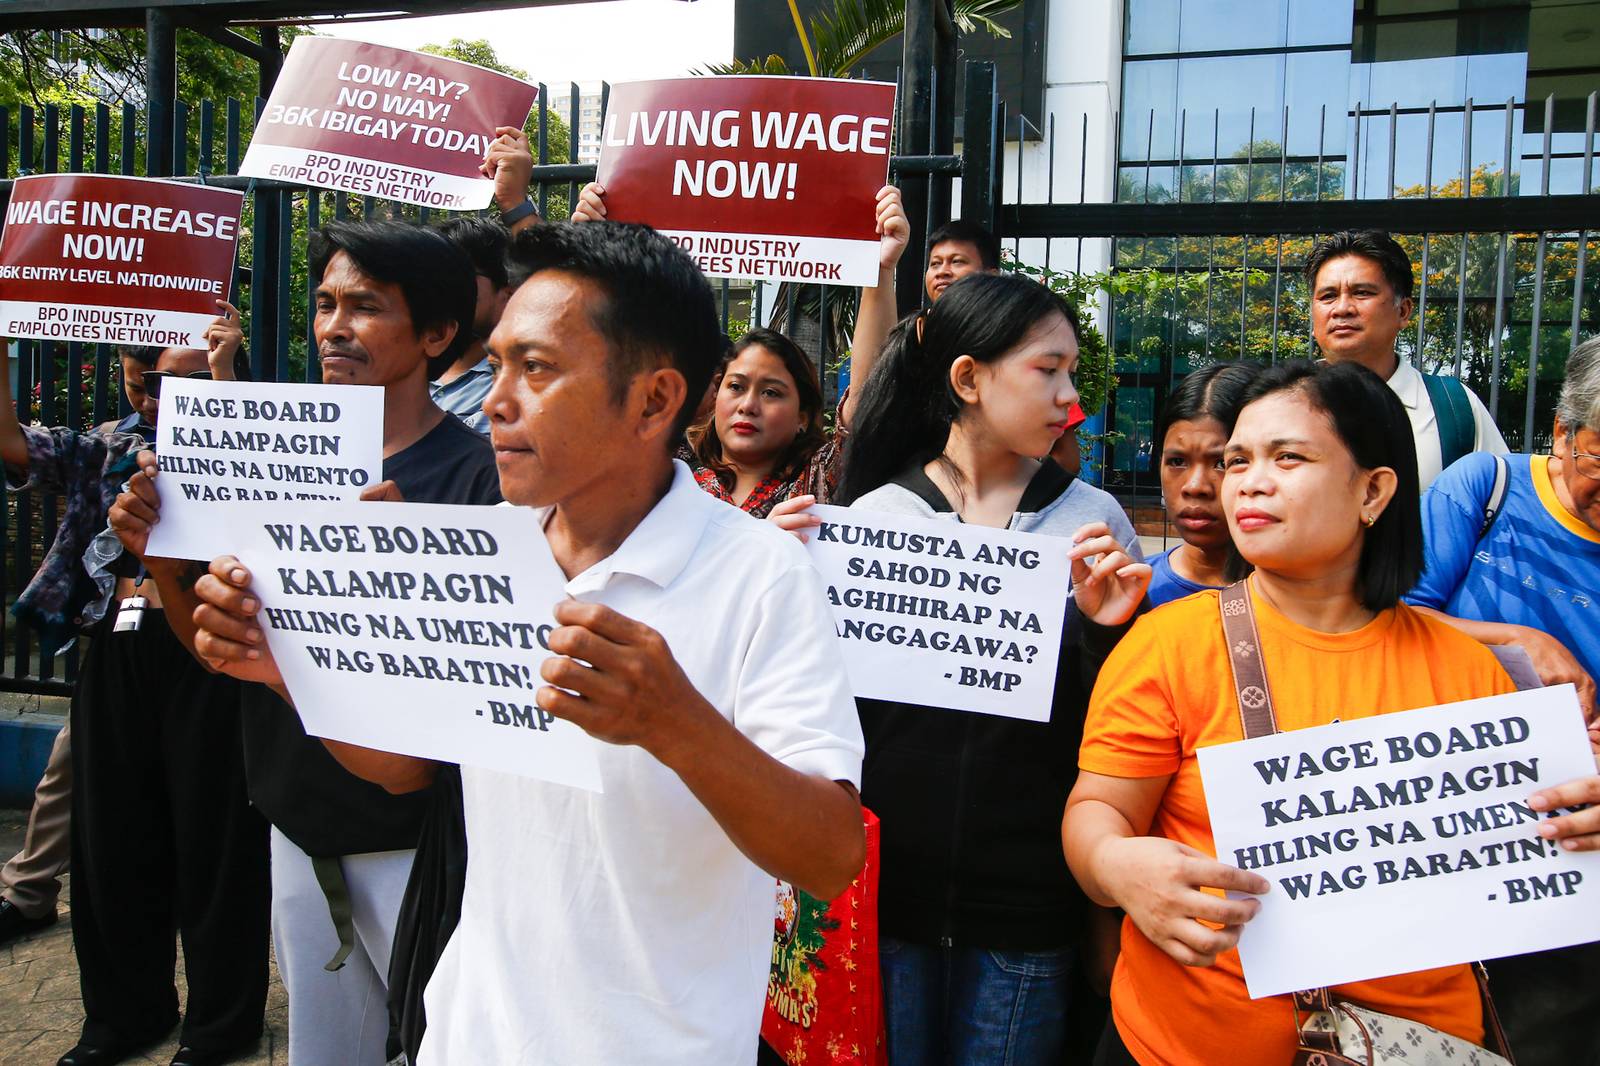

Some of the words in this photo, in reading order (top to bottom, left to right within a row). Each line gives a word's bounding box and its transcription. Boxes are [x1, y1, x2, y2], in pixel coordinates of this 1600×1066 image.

[337, 61, 401, 88] LOW
[401, 72, 470, 101] PAY?
[267, 105, 319, 128] 36K
[319, 111, 408, 141] IBIGAY
[336, 87, 379, 111] NO
[382, 94, 452, 123] WAY!
[606, 110, 740, 148] LIVING
[751, 110, 890, 155] WAGE
[269, 163, 372, 192] EMPLOYEES
[376, 182, 466, 207] NETWORK
[305, 154, 341, 171] BPO
[344, 160, 435, 188] INDUSTRY
[671, 159, 799, 200] NOW!
[8, 200, 77, 225] WAGE
[82, 201, 237, 241] INCREASE
[62, 233, 145, 263] NOW!
[699, 237, 800, 258] INDUSTRY
[22, 266, 68, 282] ENTRY
[69, 269, 114, 285] LEVEL
[117, 271, 224, 294] NATIONWIDE
[738, 258, 842, 280] NETWORK
[8, 321, 101, 339] EMPLOYEES
[105, 327, 191, 346] NETWORK
[38, 307, 68, 321] BPO
[72, 309, 156, 328] INDUSTRY
[175, 395, 238, 419] WAGE
[242, 400, 341, 423] BOARD
[172, 426, 341, 456] KALAMPAGIN
[157, 454, 227, 476] HILING
[232, 461, 264, 480] NA
[267, 463, 369, 487] UMENTO
[181, 483, 231, 501] WAG
[264, 524, 366, 553] WAGE
[368, 525, 498, 556] BOARD
[817, 522, 966, 560] KUMUSTA
[972, 543, 1041, 570] ANG
[277, 567, 515, 605] KALAMPAGIN
[847, 557, 951, 588] SAHOD
[958, 571, 1002, 595] NG
[265, 607, 361, 637] HILING
[366, 614, 414, 641] NA
[827, 585, 992, 625] AGHIHIRAP
[998, 609, 1043, 634] NA
[834, 619, 1039, 664] NGGAGAWA?
[306, 646, 375, 673] WAG
[377, 653, 534, 690] BARATIN!
[958, 666, 1022, 692] BMP
[487, 700, 555, 732] BMP
[1253, 740, 1378, 785] WAGE
[1384, 715, 1530, 763] BOARD
[1261, 757, 1540, 827] KALAMPAGIN
[1233, 828, 1360, 870] HILING
[1366, 820, 1426, 848] NA
[1279, 865, 1367, 901] WAG
[1503, 870, 1583, 904] BMP
